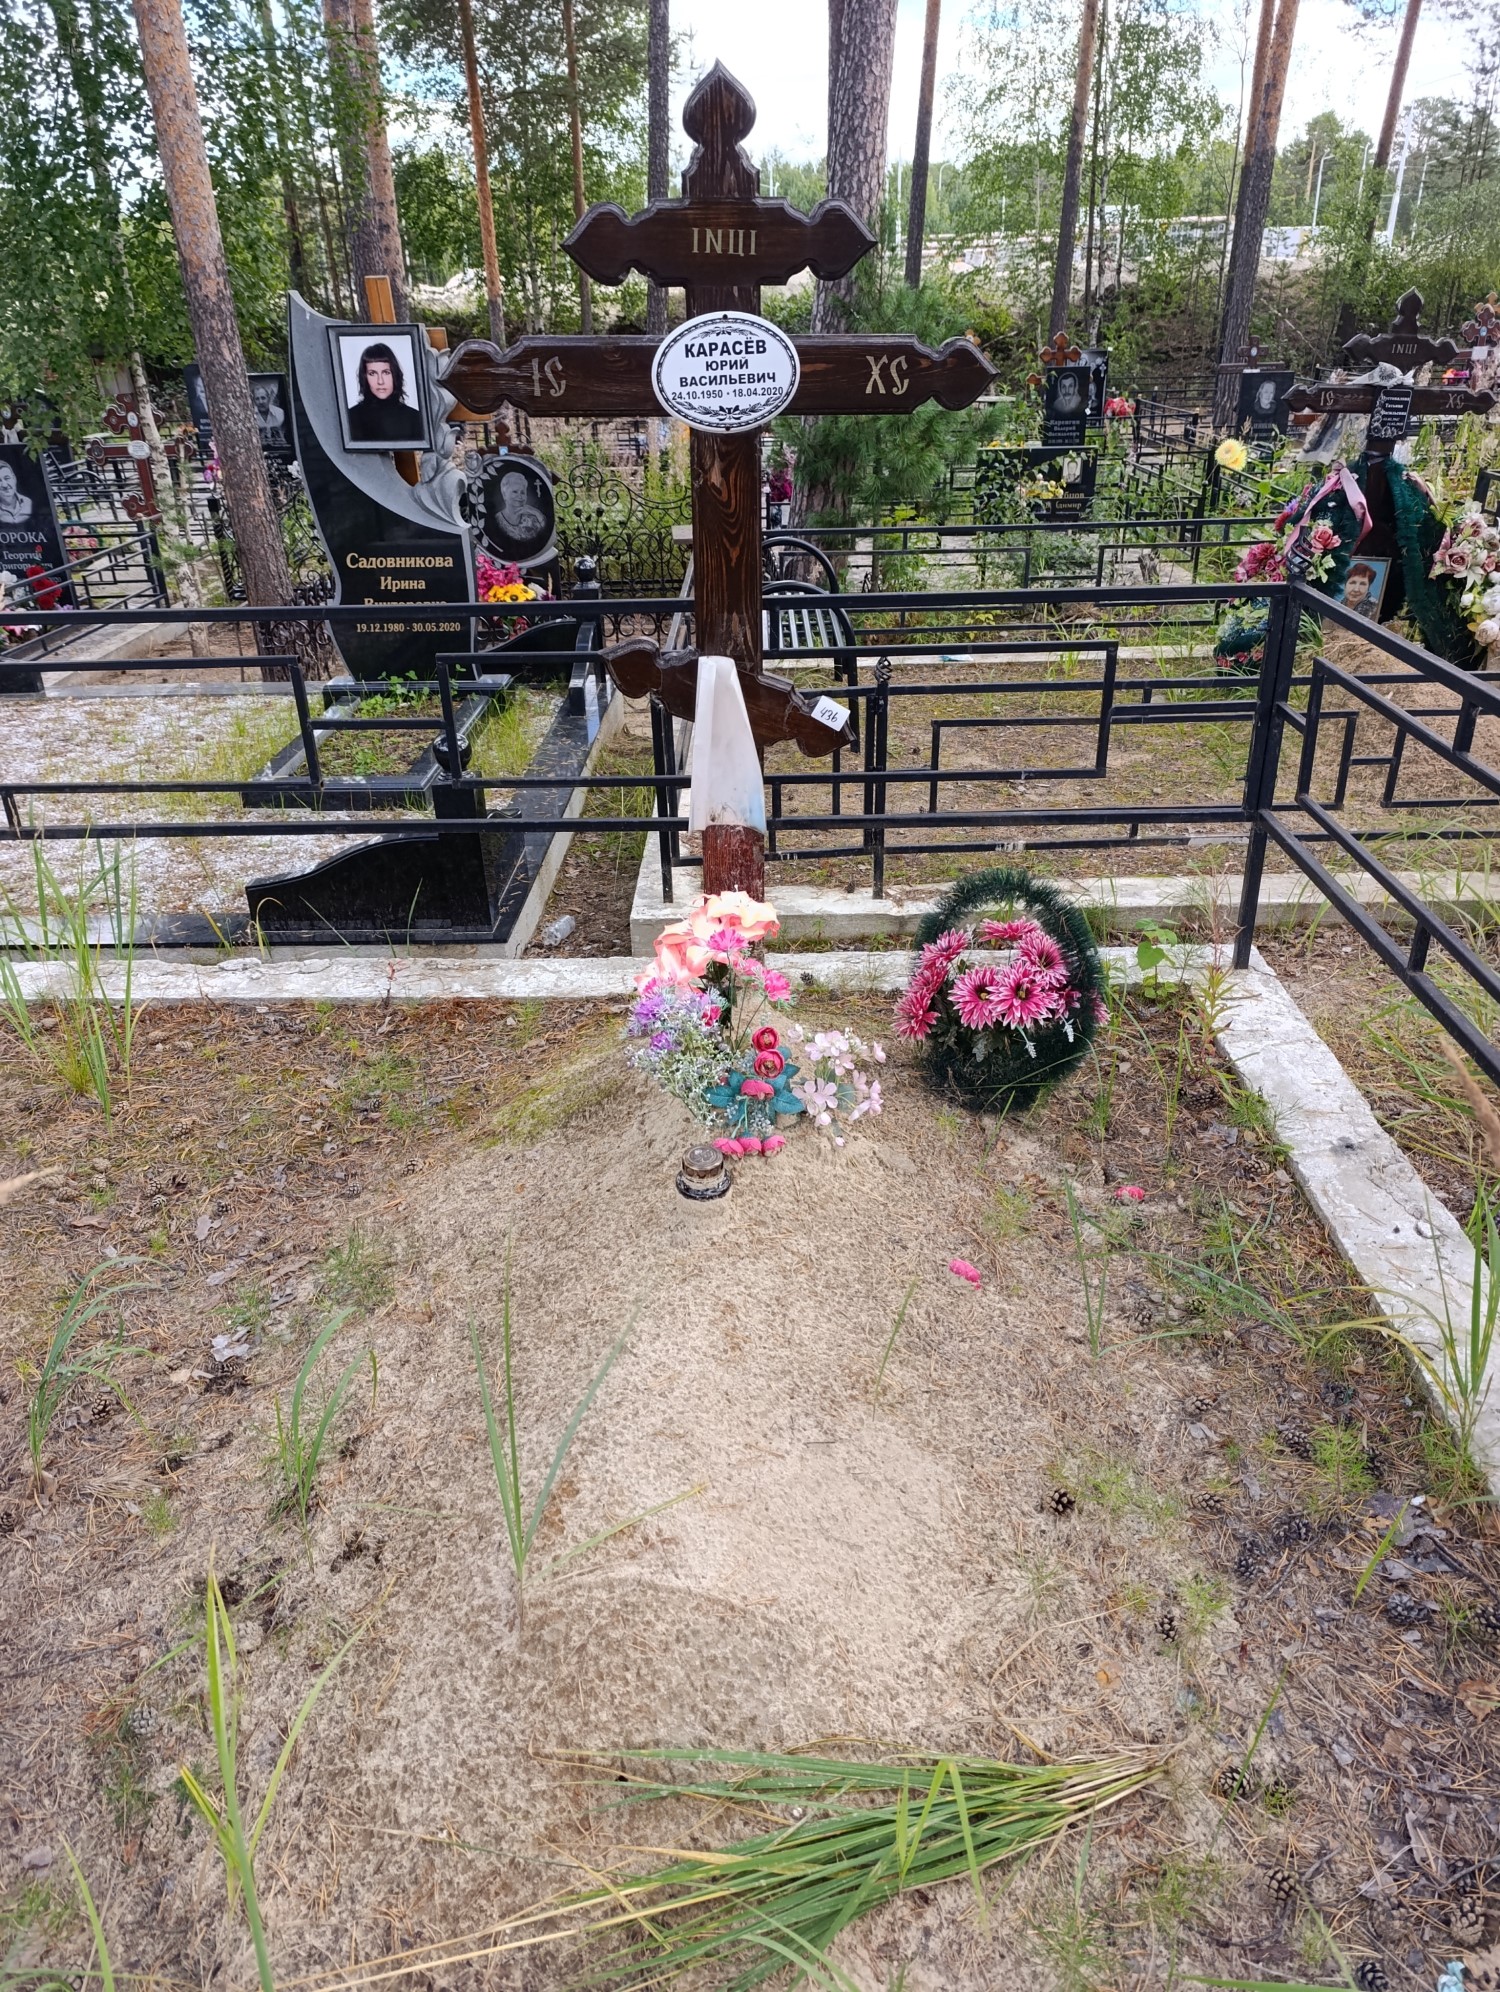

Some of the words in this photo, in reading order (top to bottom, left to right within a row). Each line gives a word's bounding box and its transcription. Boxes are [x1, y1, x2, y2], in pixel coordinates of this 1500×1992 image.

[684, 336, 767, 358] КАРАСЁВ
[705, 356, 749, 372] ЮРИЙ
[679, 372, 776, 388] ВАСИЛЬЕВИЧ
[671, 389, 723, 401] 24.10.1950
[732, 386, 784, 398] 18.04.2020
[345, 552, 454, 569] Садовникова
[379, 576, 426, 593] Ирина
[356, 623, 405, 632] 19.12.1980
[411, 622, 461, 632] 30.05.2020
